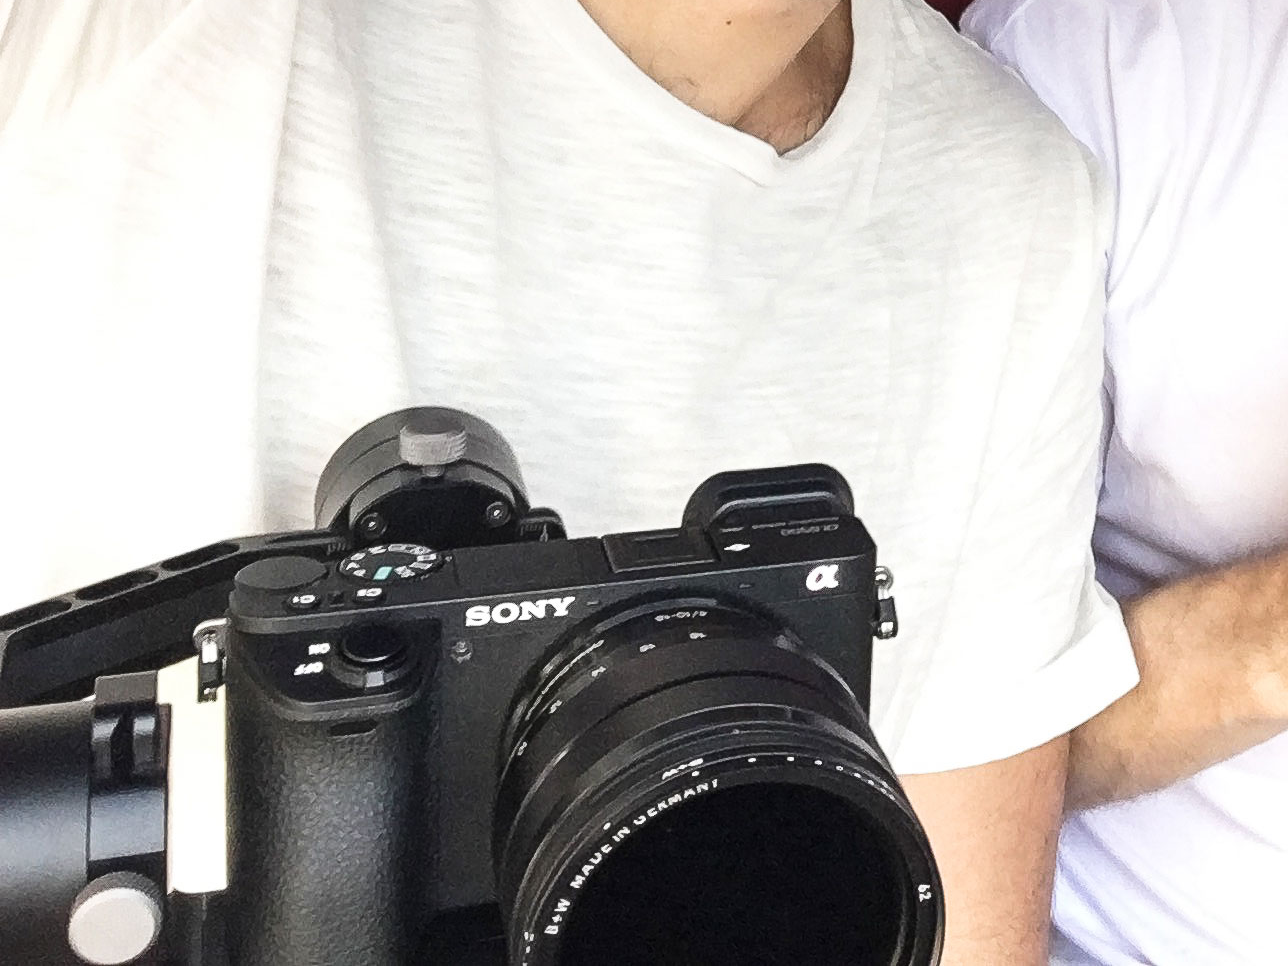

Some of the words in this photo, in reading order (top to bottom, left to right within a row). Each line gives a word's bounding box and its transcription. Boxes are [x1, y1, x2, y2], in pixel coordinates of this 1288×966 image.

[465, 596, 576, 628] SONY
[569, 843, 613, 889] MADE
[612, 826, 631, 842] IN
